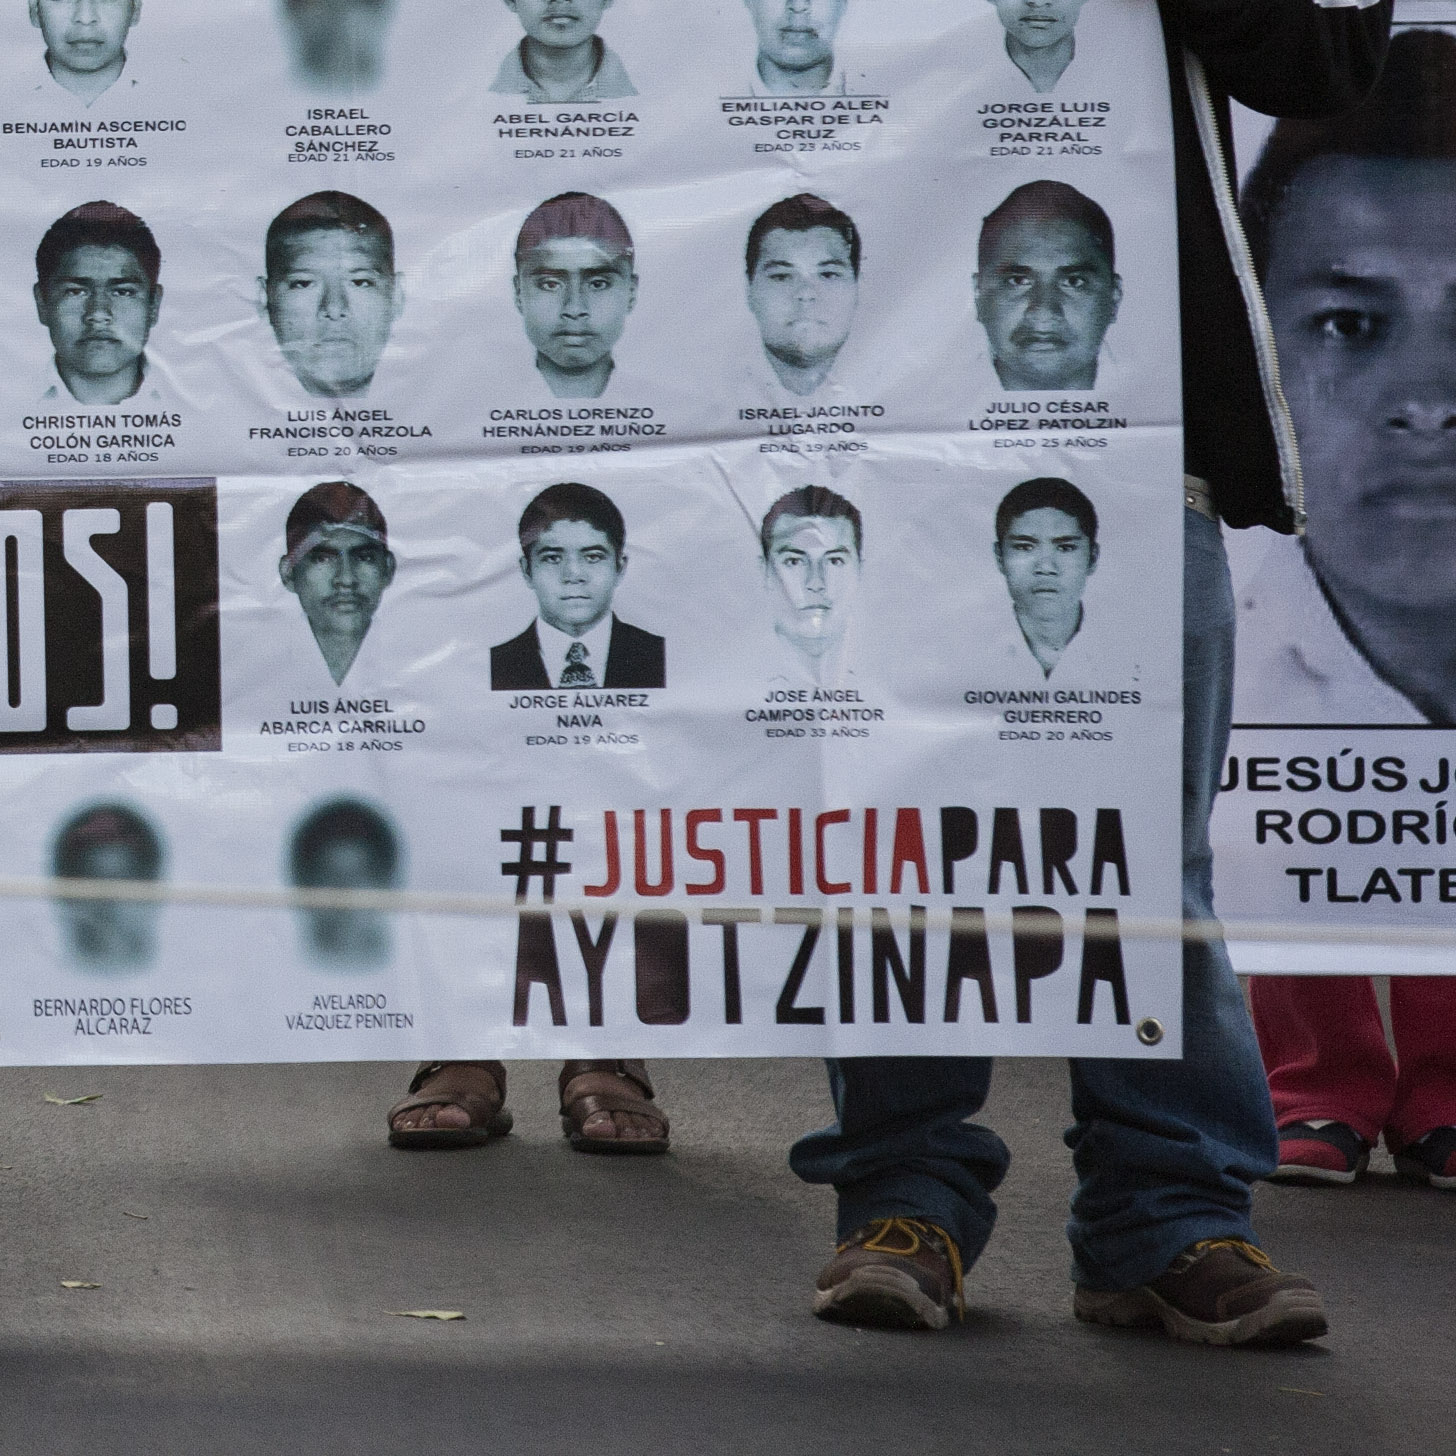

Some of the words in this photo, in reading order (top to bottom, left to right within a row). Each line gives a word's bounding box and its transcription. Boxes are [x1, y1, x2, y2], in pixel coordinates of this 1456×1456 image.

[307, 108, 370, 120] ISRAEL
[977, 102, 1054, 114] JORGE
[1060, 102, 1111, 113] LUIS
[2, 119, 92, 134] BENJAMÍN
[96, 120, 187, 133] ASCENCIO
[982, 114, 1106, 129] GONZÁLEZ
[285, 124, 392, 136] CABALLERO
[999, 131, 1089, 143] PARRAL
[53, 137, 138, 150] BAUTISTA
[294, 138, 379, 154] SÁNCHEZ
[40, 158, 81, 167] EDAD
[86, 158, 103, 167] 19
[107, 154, 148, 167] AÑOS
[985, 402, 1041, 415] JULIO
[1045, 398, 1110, 414] CÉSAR
[22, 415, 116, 429] CHRISTIAN
[120, 410, 182, 428] TOMÁS
[968, 415, 1031, 431] LÓPEZ
[1035, 418, 1129, 430] PATOLZIN
[30, 432, 91, 450] COLÓN
[96, 433, 176, 448] GARNICA
[47, 453, 89, 464] EDAD
[95, 453, 112, 462] 18
[116, 448, 159, 462] AÑOS
[509, 695, 568, 709] JORGE
[573, 690, 649, 708] ÁLVAREZ
[963, 691, 1050, 704] GIOVANNI
[1052, 690, 1142, 705] GALINDES
[556, 714, 604, 728] NAVA
[1003, 709, 1103, 724] GUERRERO
[1220, 747, 1408, 793] JESÚS
[1418, 756, 1456, 794] J
[1255, 799, 1456, 845] RODRÍ
[511, 904, 1131, 1027] AYOTZINAPA
[33, 998, 126, 1016] BERNARDO
[130, 997, 193, 1016] FLORES
[312, 993, 387, 1010] AVELARDO
[74, 1016, 153, 1036] ALCARAZ
[285, 1010, 353, 1031] VÁZQUEZ
[355, 1013, 414, 1029] PENITEN
